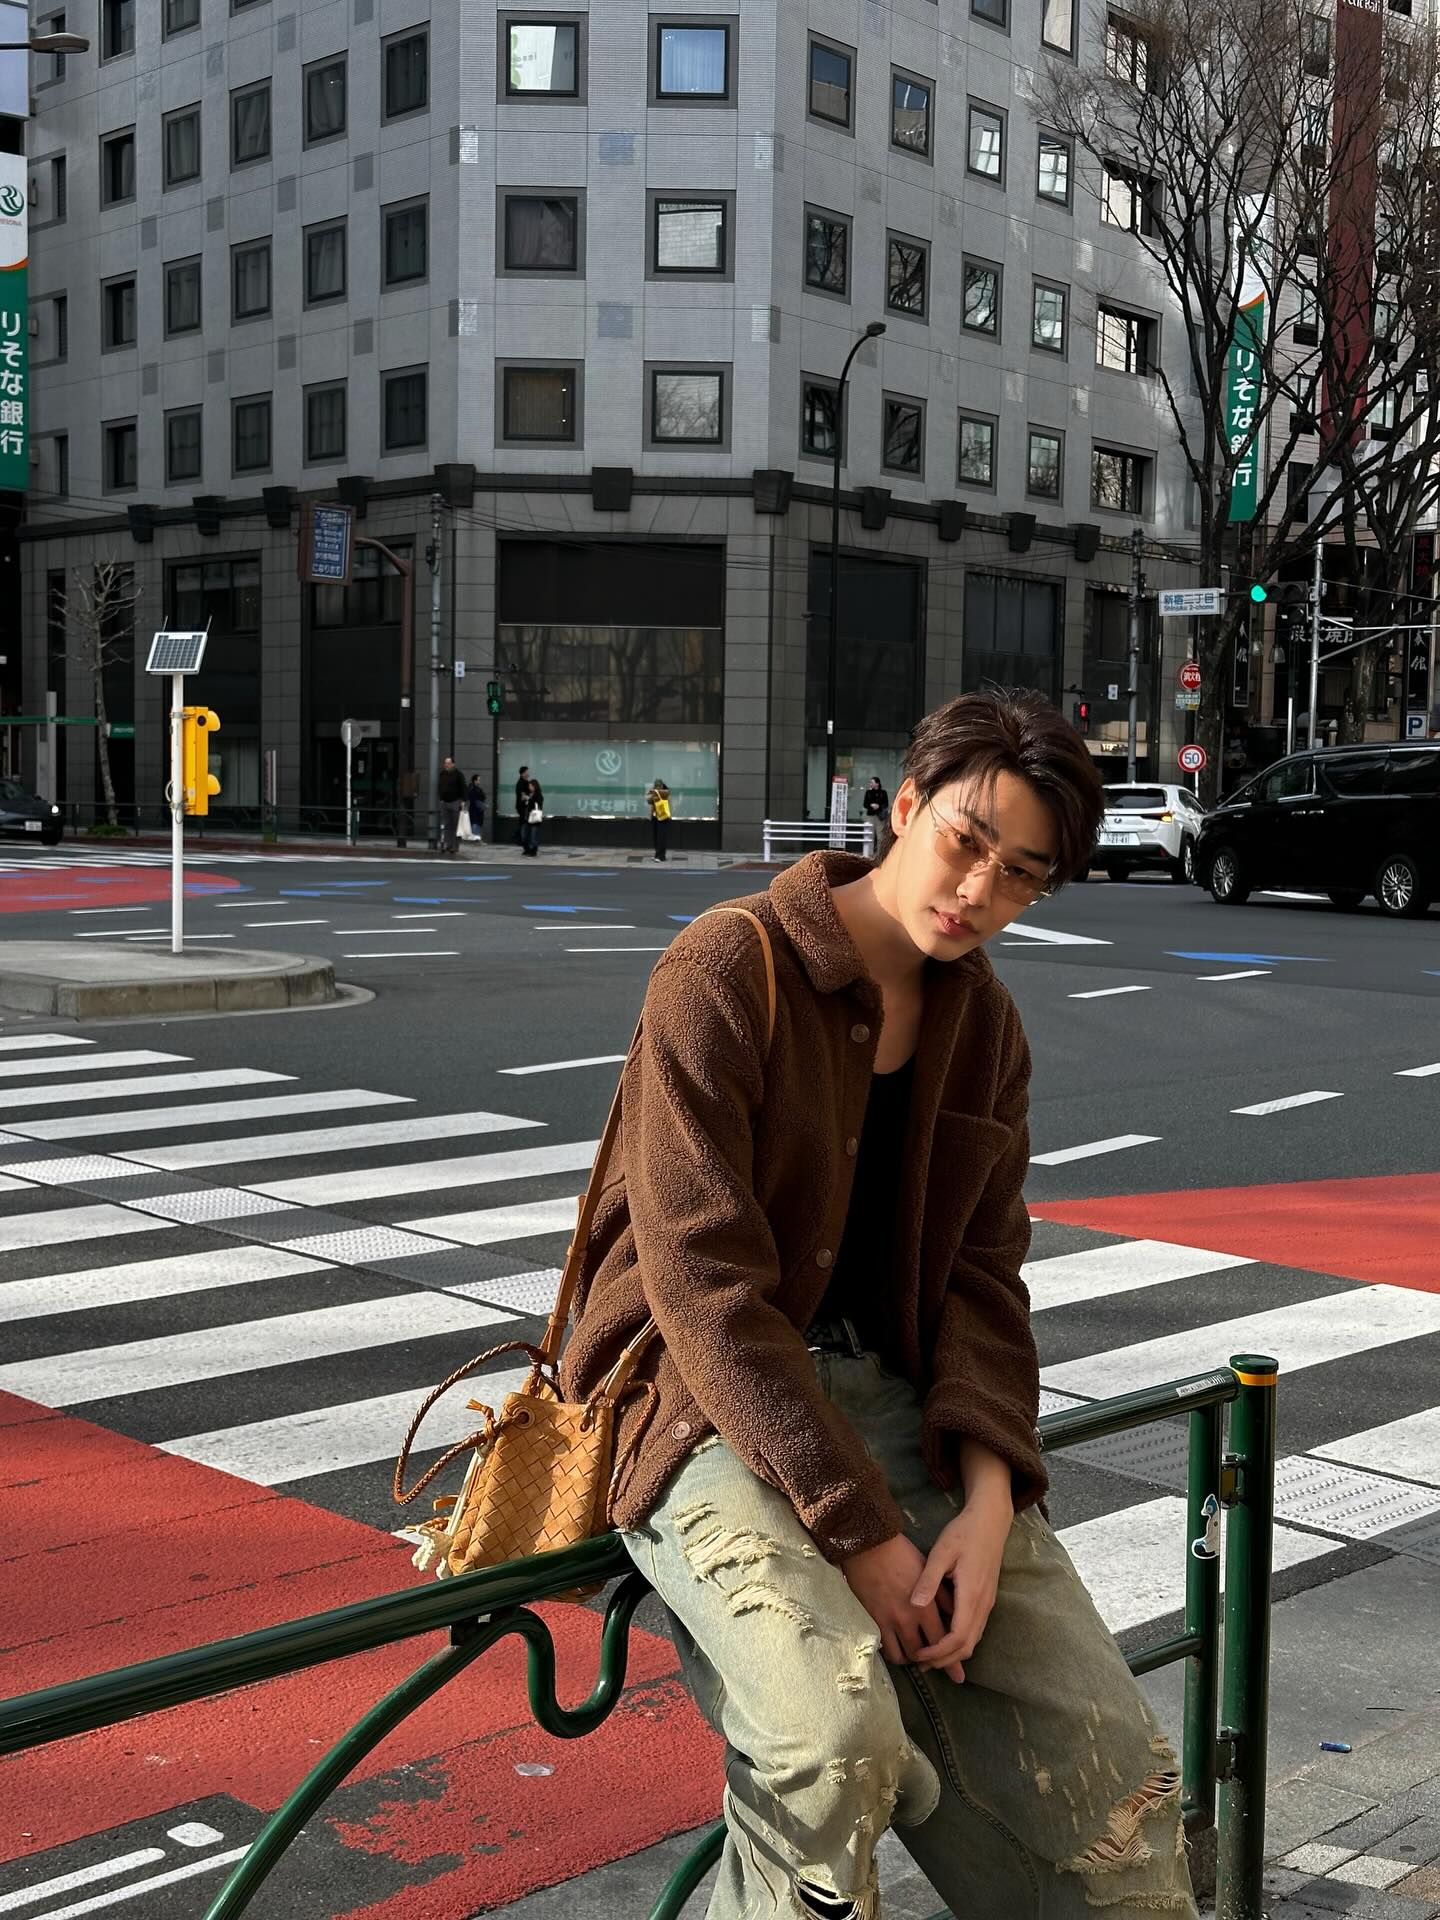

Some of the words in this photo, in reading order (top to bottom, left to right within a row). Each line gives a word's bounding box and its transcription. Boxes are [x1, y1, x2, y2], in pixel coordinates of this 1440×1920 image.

[0, 311, 24, 455] りそな銀行
[1164, 593, 1214, 605] 新宿二丁目
[1408, 717, 1423, 735] P
[1184, 752, 1200, 764] 50
